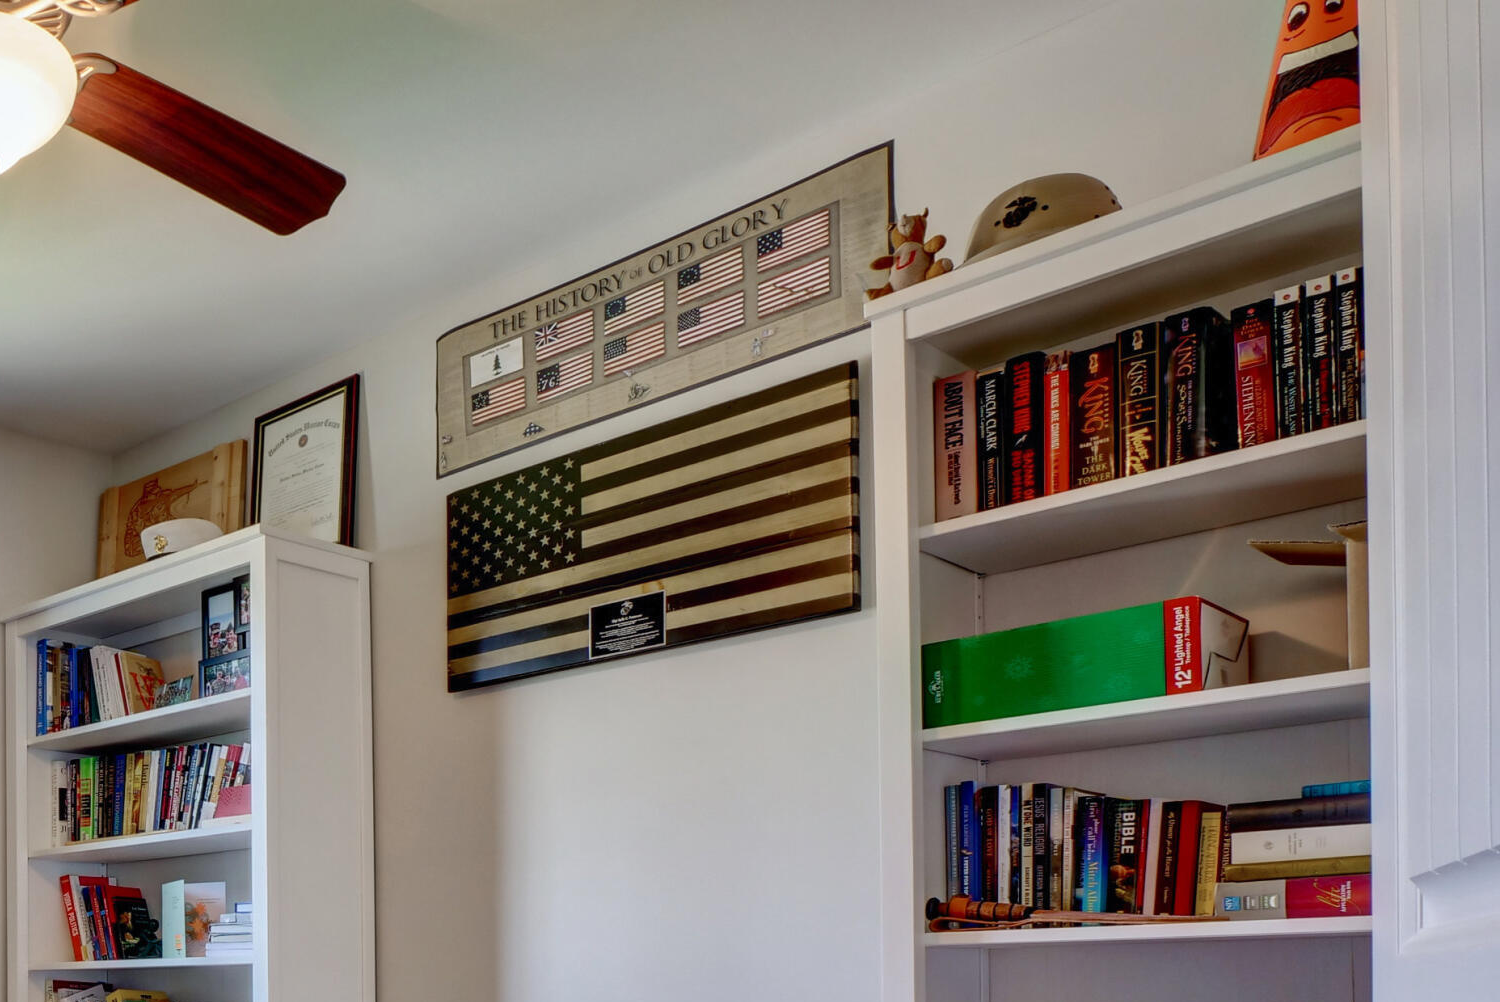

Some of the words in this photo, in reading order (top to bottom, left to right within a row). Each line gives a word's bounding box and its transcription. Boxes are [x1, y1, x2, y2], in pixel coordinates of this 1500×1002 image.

[488, 310, 527, 339] THE
[535, 270, 628, 322] HISTORY
[648, 241, 696, 275] OLD
[702, 198, 789, 250] GLORY
[1312, 298, 1327, 334] Stephen
[1339, 290, 1356, 327] Stephen
[1280, 309, 1296, 345] Stephen
[1340, 329, 1356, 351] King
[1172, 333, 1196, 377] KING
[1281, 346, 1296, 368] King
[1313, 336, 1327, 358] King
[541, 375, 556, 391] 76
[1013, 362, 1030, 408] STEPHEN
[1050, 375, 1059, 387] THE
[1127, 360, 1147, 397] KING
[944, 382, 963, 418] ABOUT
[985, 380, 996, 418] MARCIA
[1051, 389, 1059, 408] YANKS
[1078, 377, 1109, 433] KING
[1241, 375, 1254, 422] STEPHEN
[1287, 387, 1297, 412] WASTE
[1013, 408, 1030, 434] KING
[1051, 410, 1059, 421] ARE
[945, 420, 964, 449] FACE
[986, 419, 997, 451] CLARK
[1082, 463, 1108, 476] DARK
[1085, 453, 1103, 464] THE
[1077, 471, 1111, 486] TOWER
[1173, 606, 1185, 632] Angel
[1174, 633, 1186, 666] Lighted
[1023, 800, 1032, 811] MY
[1024, 812, 1032, 824] ONE
[1035, 798, 1045, 818] JESUS
[1089, 802, 1098, 818] first
[1023, 827, 1032, 847] WORD
[1035, 824, 1045, 855] RELIGION
[1087, 827, 1095, 841] call
[1121, 812, 1136, 854] BIBLE
[1087, 862, 1099, 888] Mitch
[68, 913, 78, 937] POLITICS
